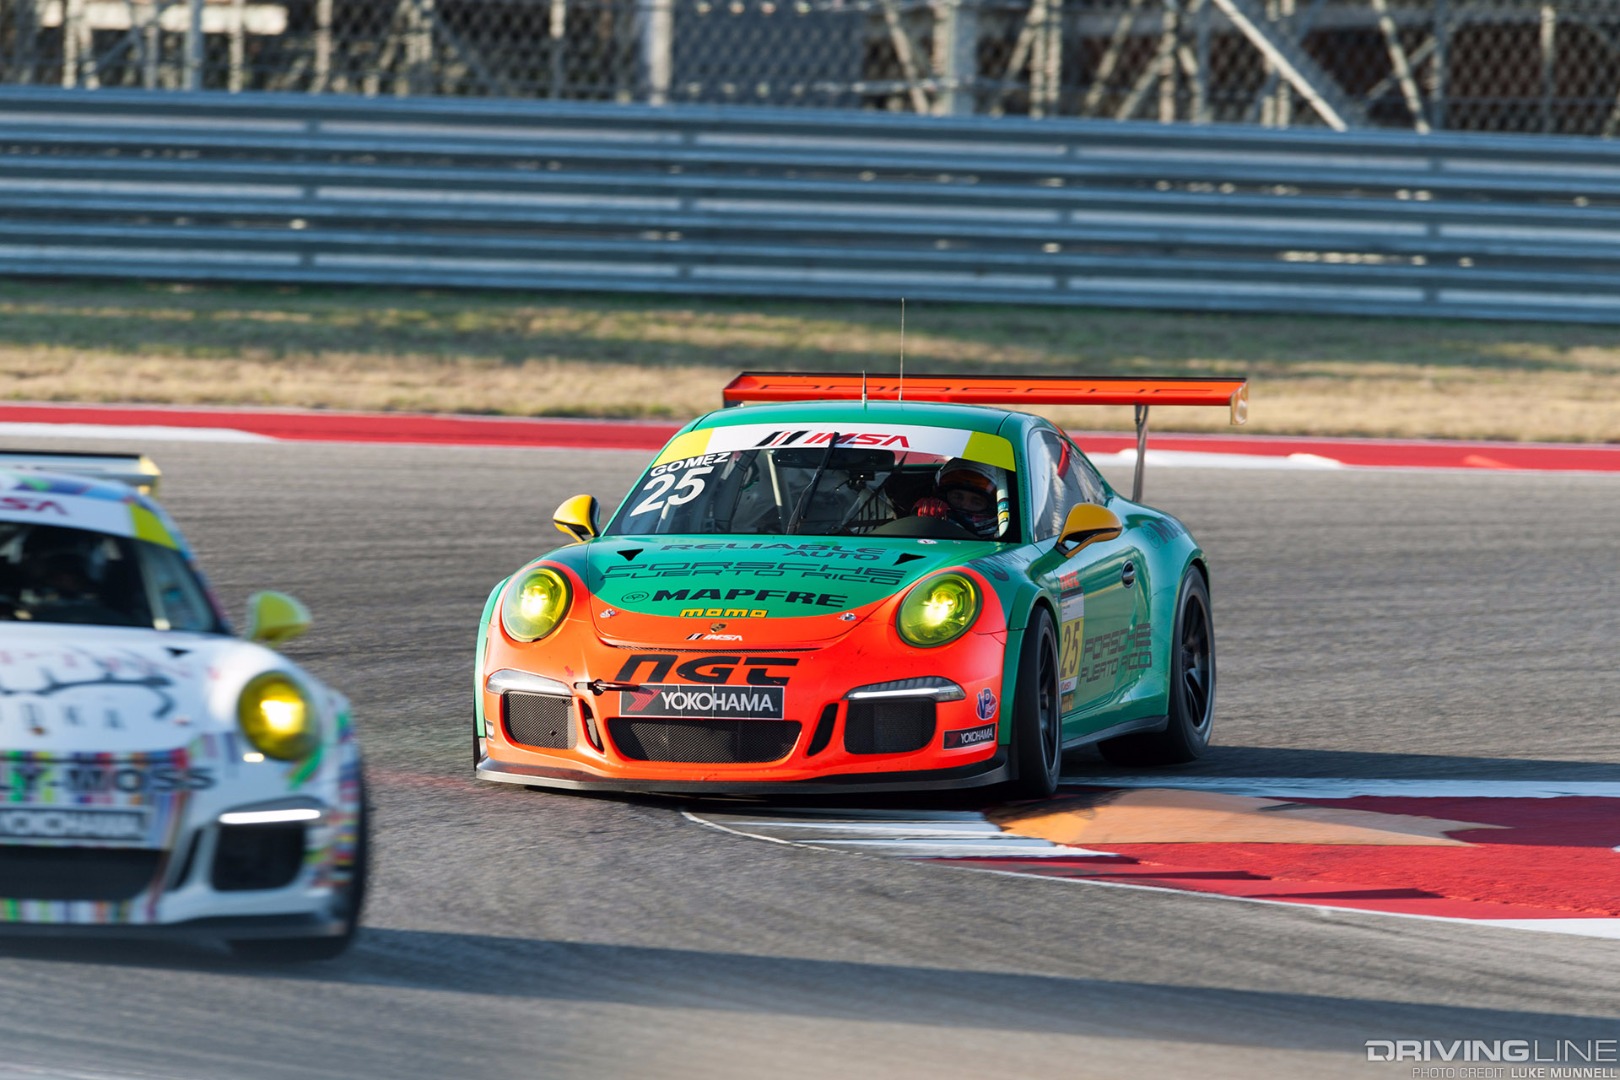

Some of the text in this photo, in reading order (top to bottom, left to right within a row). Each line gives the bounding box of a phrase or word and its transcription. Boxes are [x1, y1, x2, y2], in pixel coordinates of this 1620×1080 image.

[804, 432, 910, 448] IMSA
[650, 452, 732, 477] GOMEZ
[629, 465, 715, 517] 25
[660, 543, 887, 555] RELIABLE
[782, 550, 881, 561] AUTO
[603, 569, 901, 586] PUERTO RICO
[605, 561, 907, 579] PORSCHE
[652, 588, 848, 608] MAPFRE
[703, 633, 743, 641] IMSA
[1060, 621, 1080, 678] 25
[661, 692, 774, 712] YOKOHAMA
[961, 728, 993, 743] YOKOHAMA
